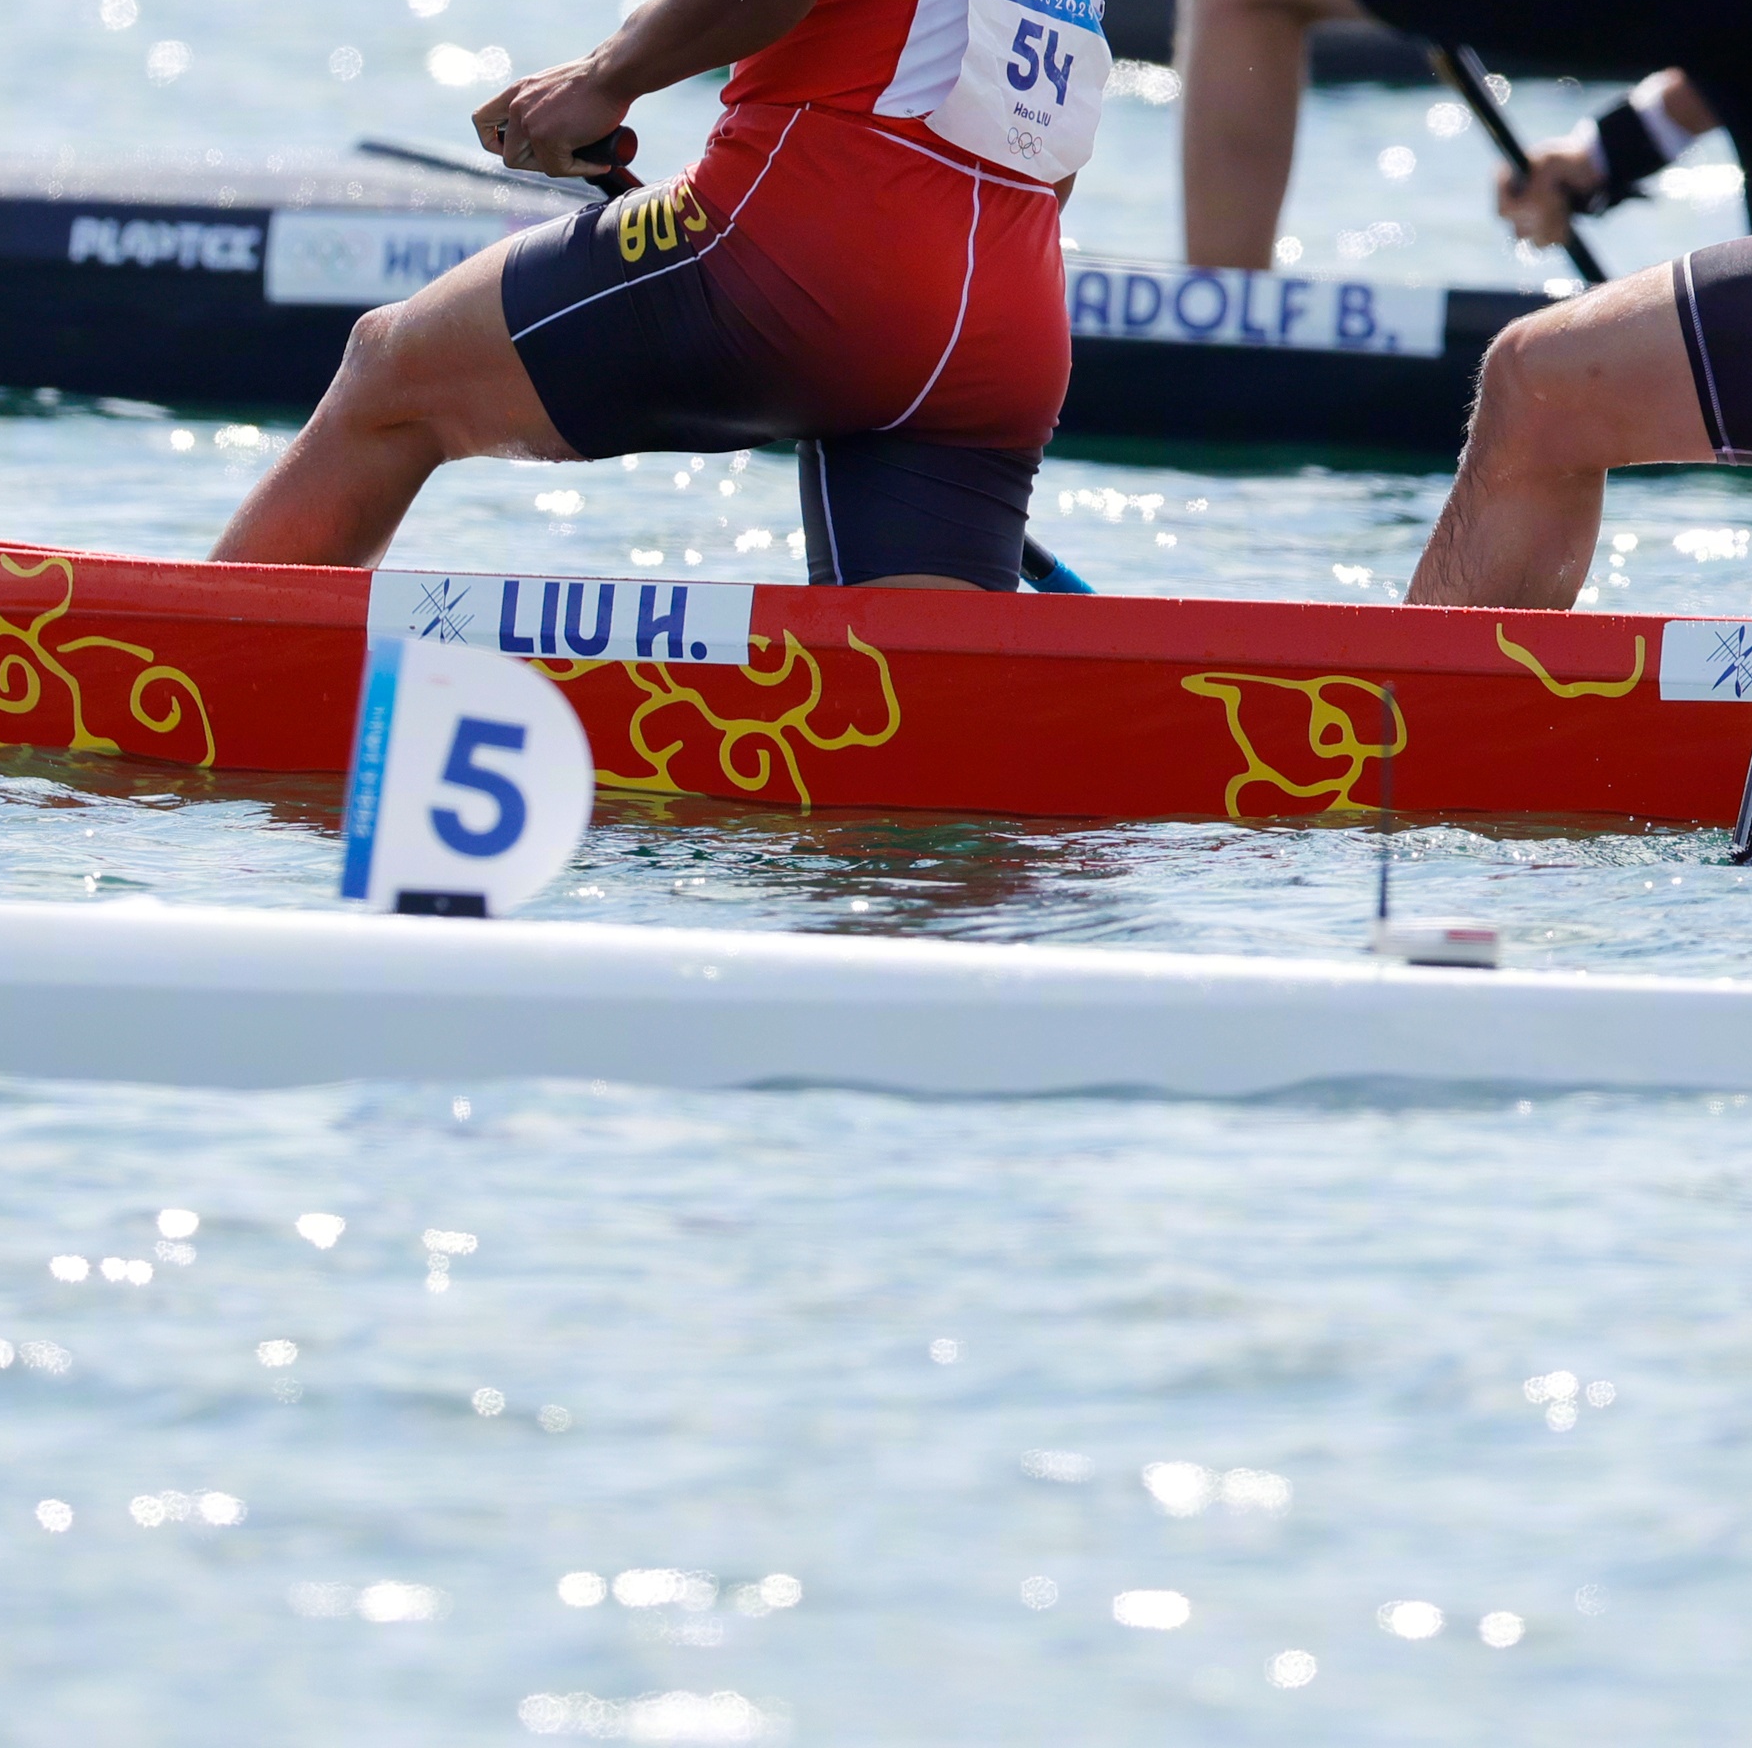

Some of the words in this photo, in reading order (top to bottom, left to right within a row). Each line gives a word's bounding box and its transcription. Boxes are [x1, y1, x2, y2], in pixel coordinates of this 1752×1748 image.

[1007, 18, 1074, 106] 54
[1013, 102, 1035, 120] Hao
[1036, 110, 1052, 126] LIU
[1072, 271, 1311, 343] ADOLF
[1337, 283, 1400, 351] B.
[499, 580, 615, 658] LIU
[636, 586, 708, 661] H.
[429, 716, 528, 857] 5
